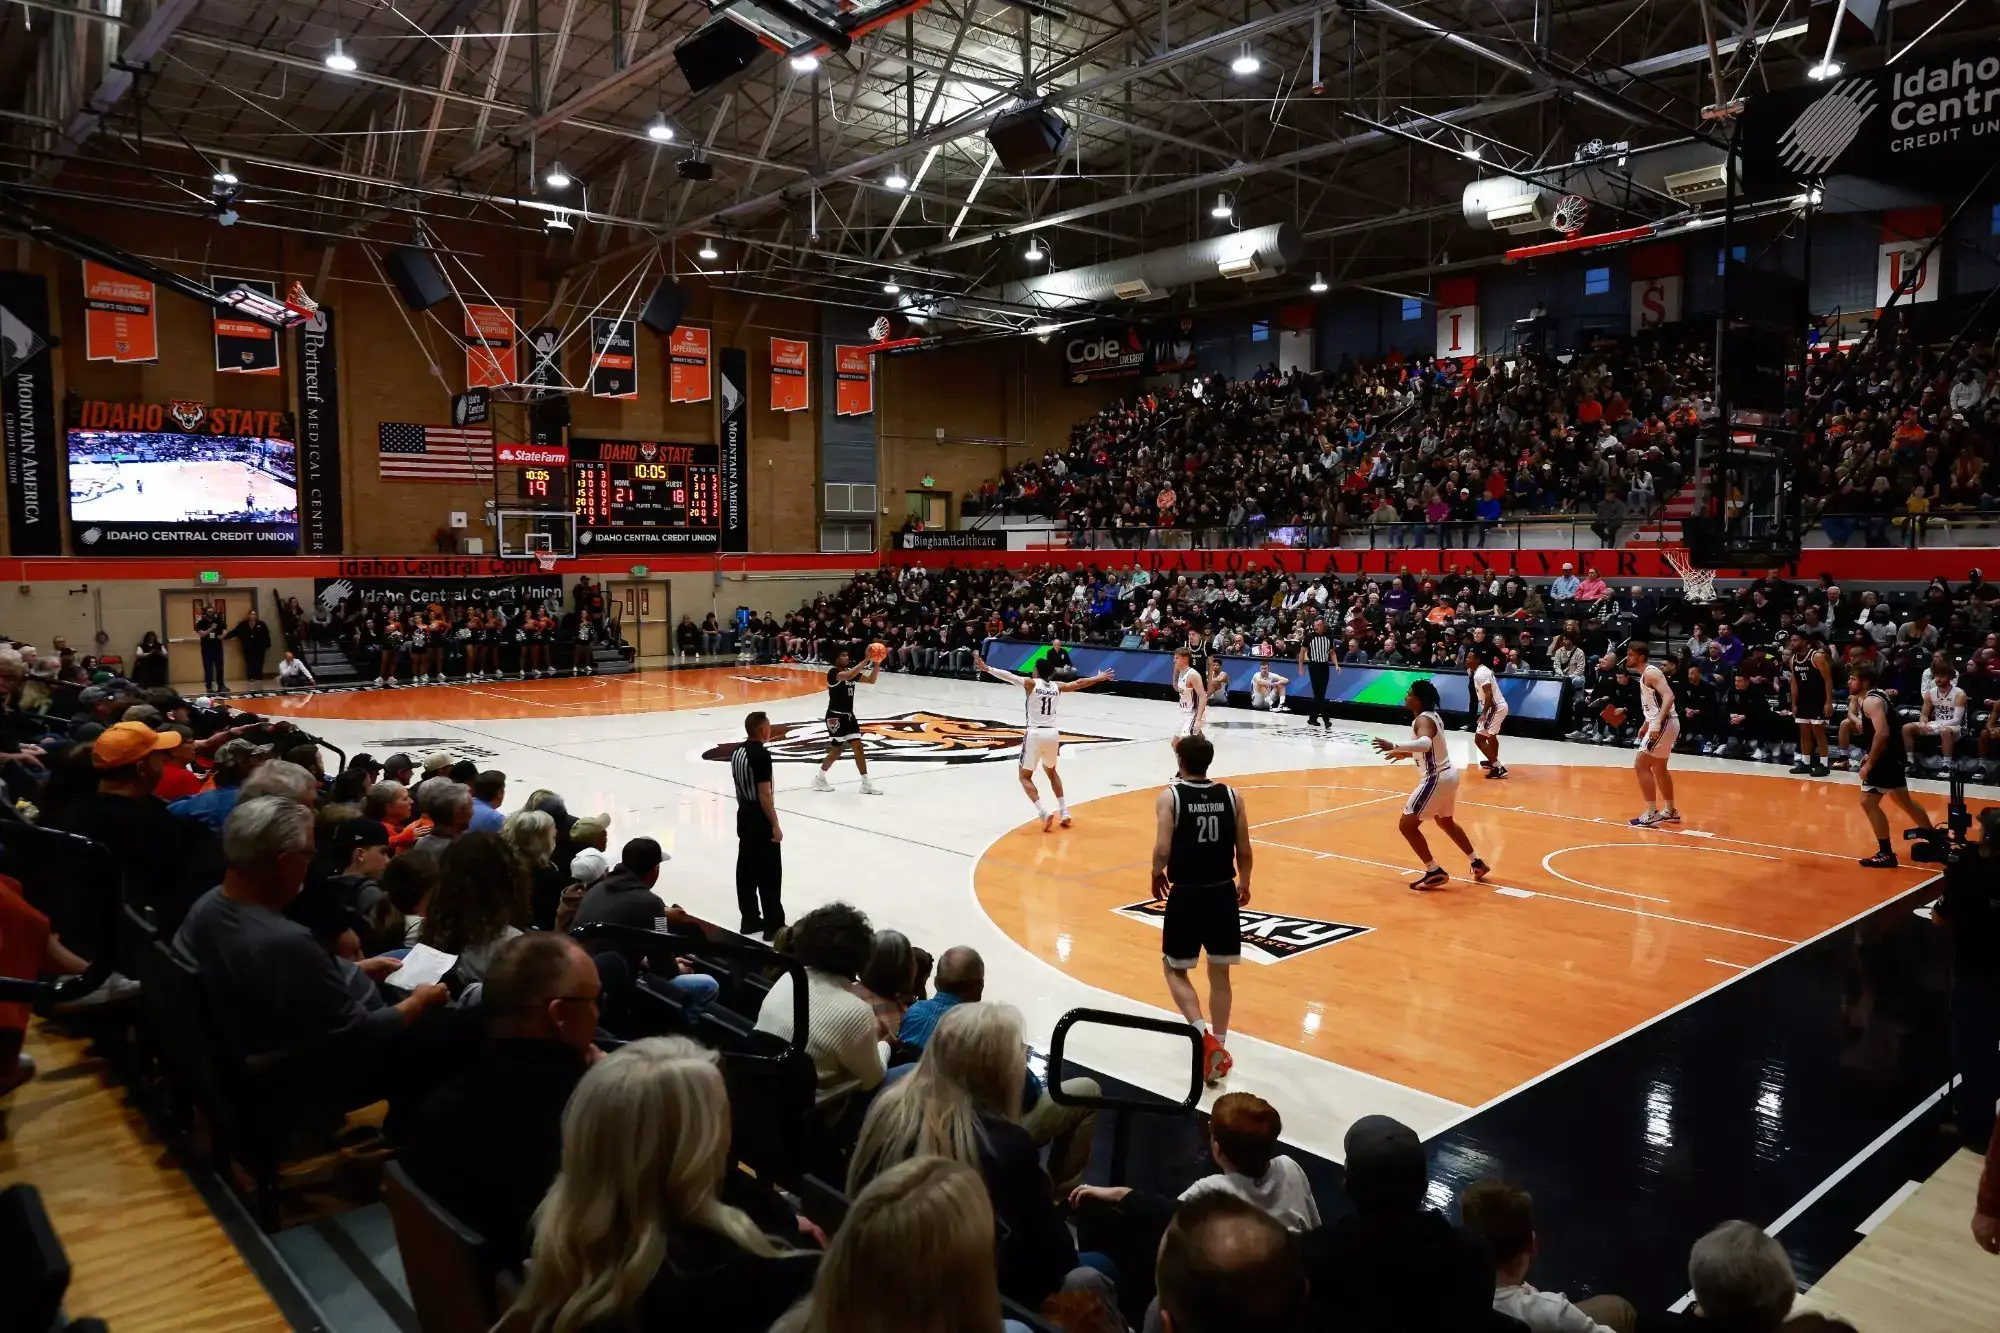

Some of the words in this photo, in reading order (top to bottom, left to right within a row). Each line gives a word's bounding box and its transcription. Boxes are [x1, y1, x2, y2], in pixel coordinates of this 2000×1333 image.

[1893, 56, 2000, 100] Idaho
[1891, 127, 1961, 153] CREDIT
[1641, 282, 1666, 327] S
[598, 337, 630, 347] CHAMPIONS
[1448, 313, 1462, 352] I
[672, 344, 708, 354] APPEARANCES
[1066, 336, 1120, 363] Cole
[305, 332, 325, 403] Portneuf
[18, 373, 36, 454] MOUNTAIN
[80, 400, 163, 431] IDAHO
[210, 408, 283, 437] STATE
[6, 412, 16, 449] CREDIT
[307, 408, 321, 479] MEDICAL
[600, 444, 637, 461] IDAHO
[660, 446, 695, 462] STATE
[728, 420, 738, 479] MOUNTAIN
[8, 451, 18, 484] UNION
[525, 470, 550, 481] 10:05
[634, 464, 667, 479] 10:05
[21, 457, 40, 525] AMERICA
[529, 481, 547, 496] 19
[616, 488, 634, 502] 21
[672, 489, 684, 503] 18
[311, 488, 323, 550] CENTER
[729, 481, 739, 530] AMERICA
[106, 531, 149, 541] IDAHO
[151, 531, 208, 541] CENTRAL
[211, 532, 254, 541] CREDIT
[256, 532, 294, 541] UNION
[595, 534, 622, 542] IDAHO
[624, 534, 661, 542] CENTRAL
[662, 534, 691, 542] CREDIT
[692, 534, 717, 542] UNION
[338, 556, 399, 576] Idaho
[404, 556, 479, 576] Central
[1272, 550, 1402, 573] STATE
[1041, 696, 1052, 716] 11
[1196, 815, 1219, 843] 20
